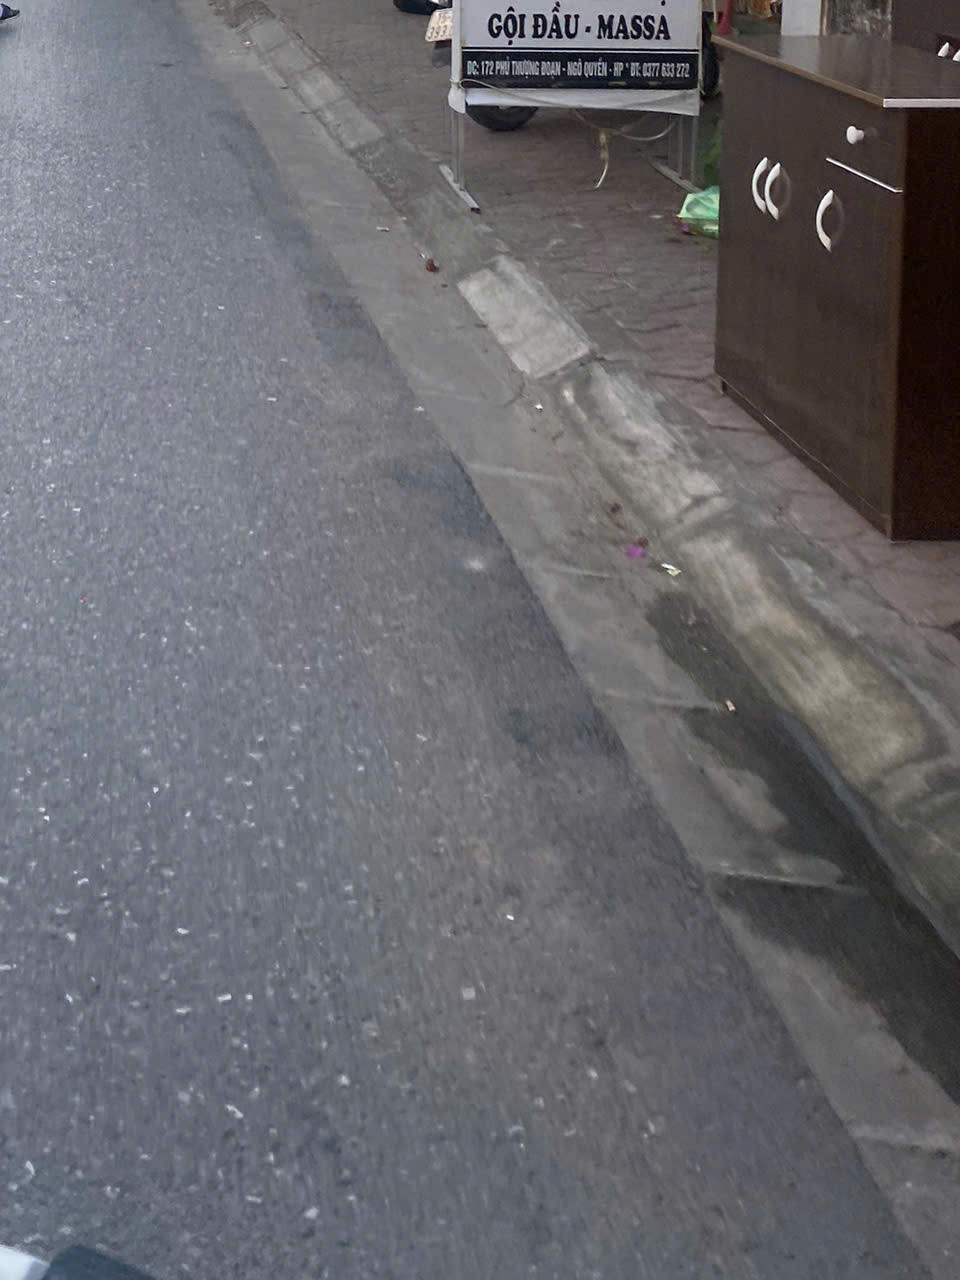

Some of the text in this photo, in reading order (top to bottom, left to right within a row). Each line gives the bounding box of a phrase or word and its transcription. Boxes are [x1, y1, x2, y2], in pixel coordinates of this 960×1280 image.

[488, 6, 526, 45] GỘI
[532, 1, 580, 39] ĐẦU
[597, 14, 671, 40] MASSA
[481, 61, 494, 75] 172
[613, 62, 624, 76] HP
[676, 63, 690, 78] 272
